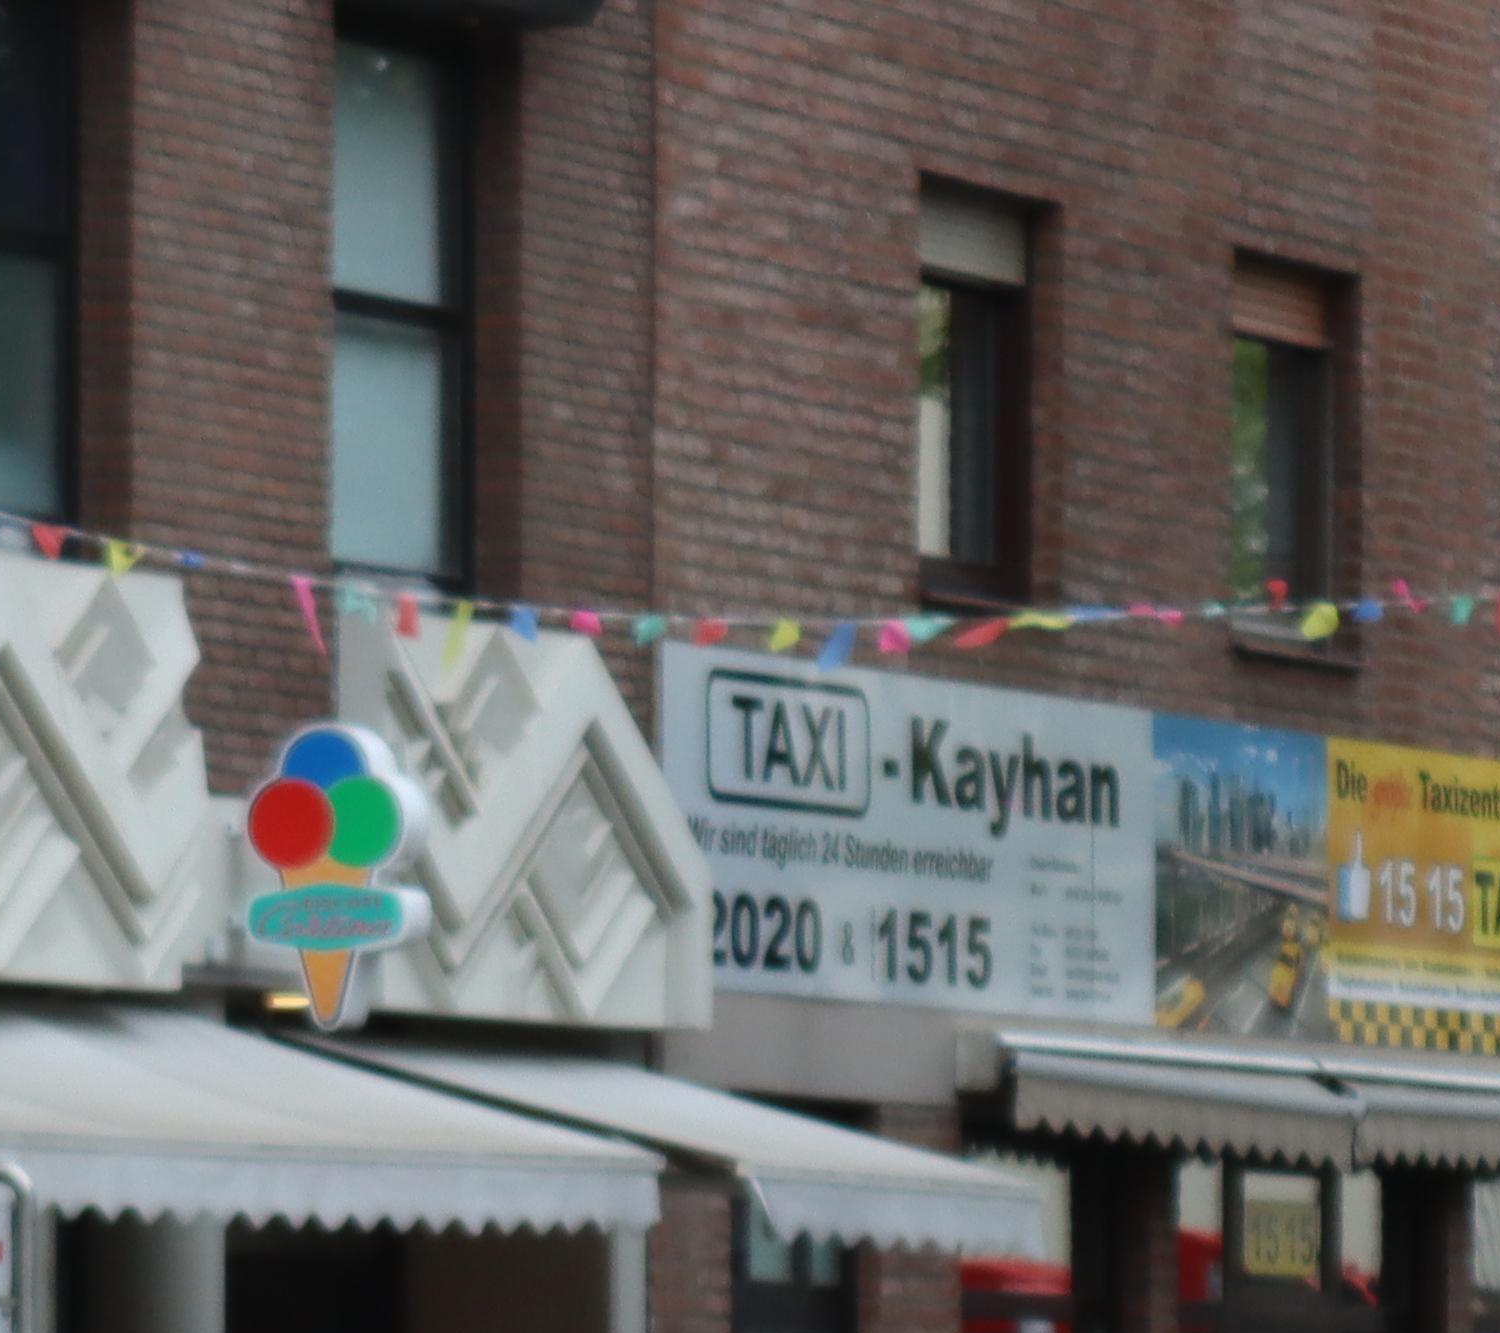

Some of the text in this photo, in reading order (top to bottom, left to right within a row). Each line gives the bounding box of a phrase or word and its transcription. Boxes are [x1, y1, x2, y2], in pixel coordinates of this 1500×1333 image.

[730, 693, 847, 792] TAXI
[1335, 758, 1369, 803] Die
[719, 823, 757, 858] sind
[760, 829, 818, 869] täglich
[820, 831, 840, 863] 24
[844, 836, 908, 873] Stunden
[912, 845, 994, 884] erreichbar
[1378, 856, 1418, 929] 15
[1427, 863, 1465, 935] 15
[877, 904, 993, 990] 1515
